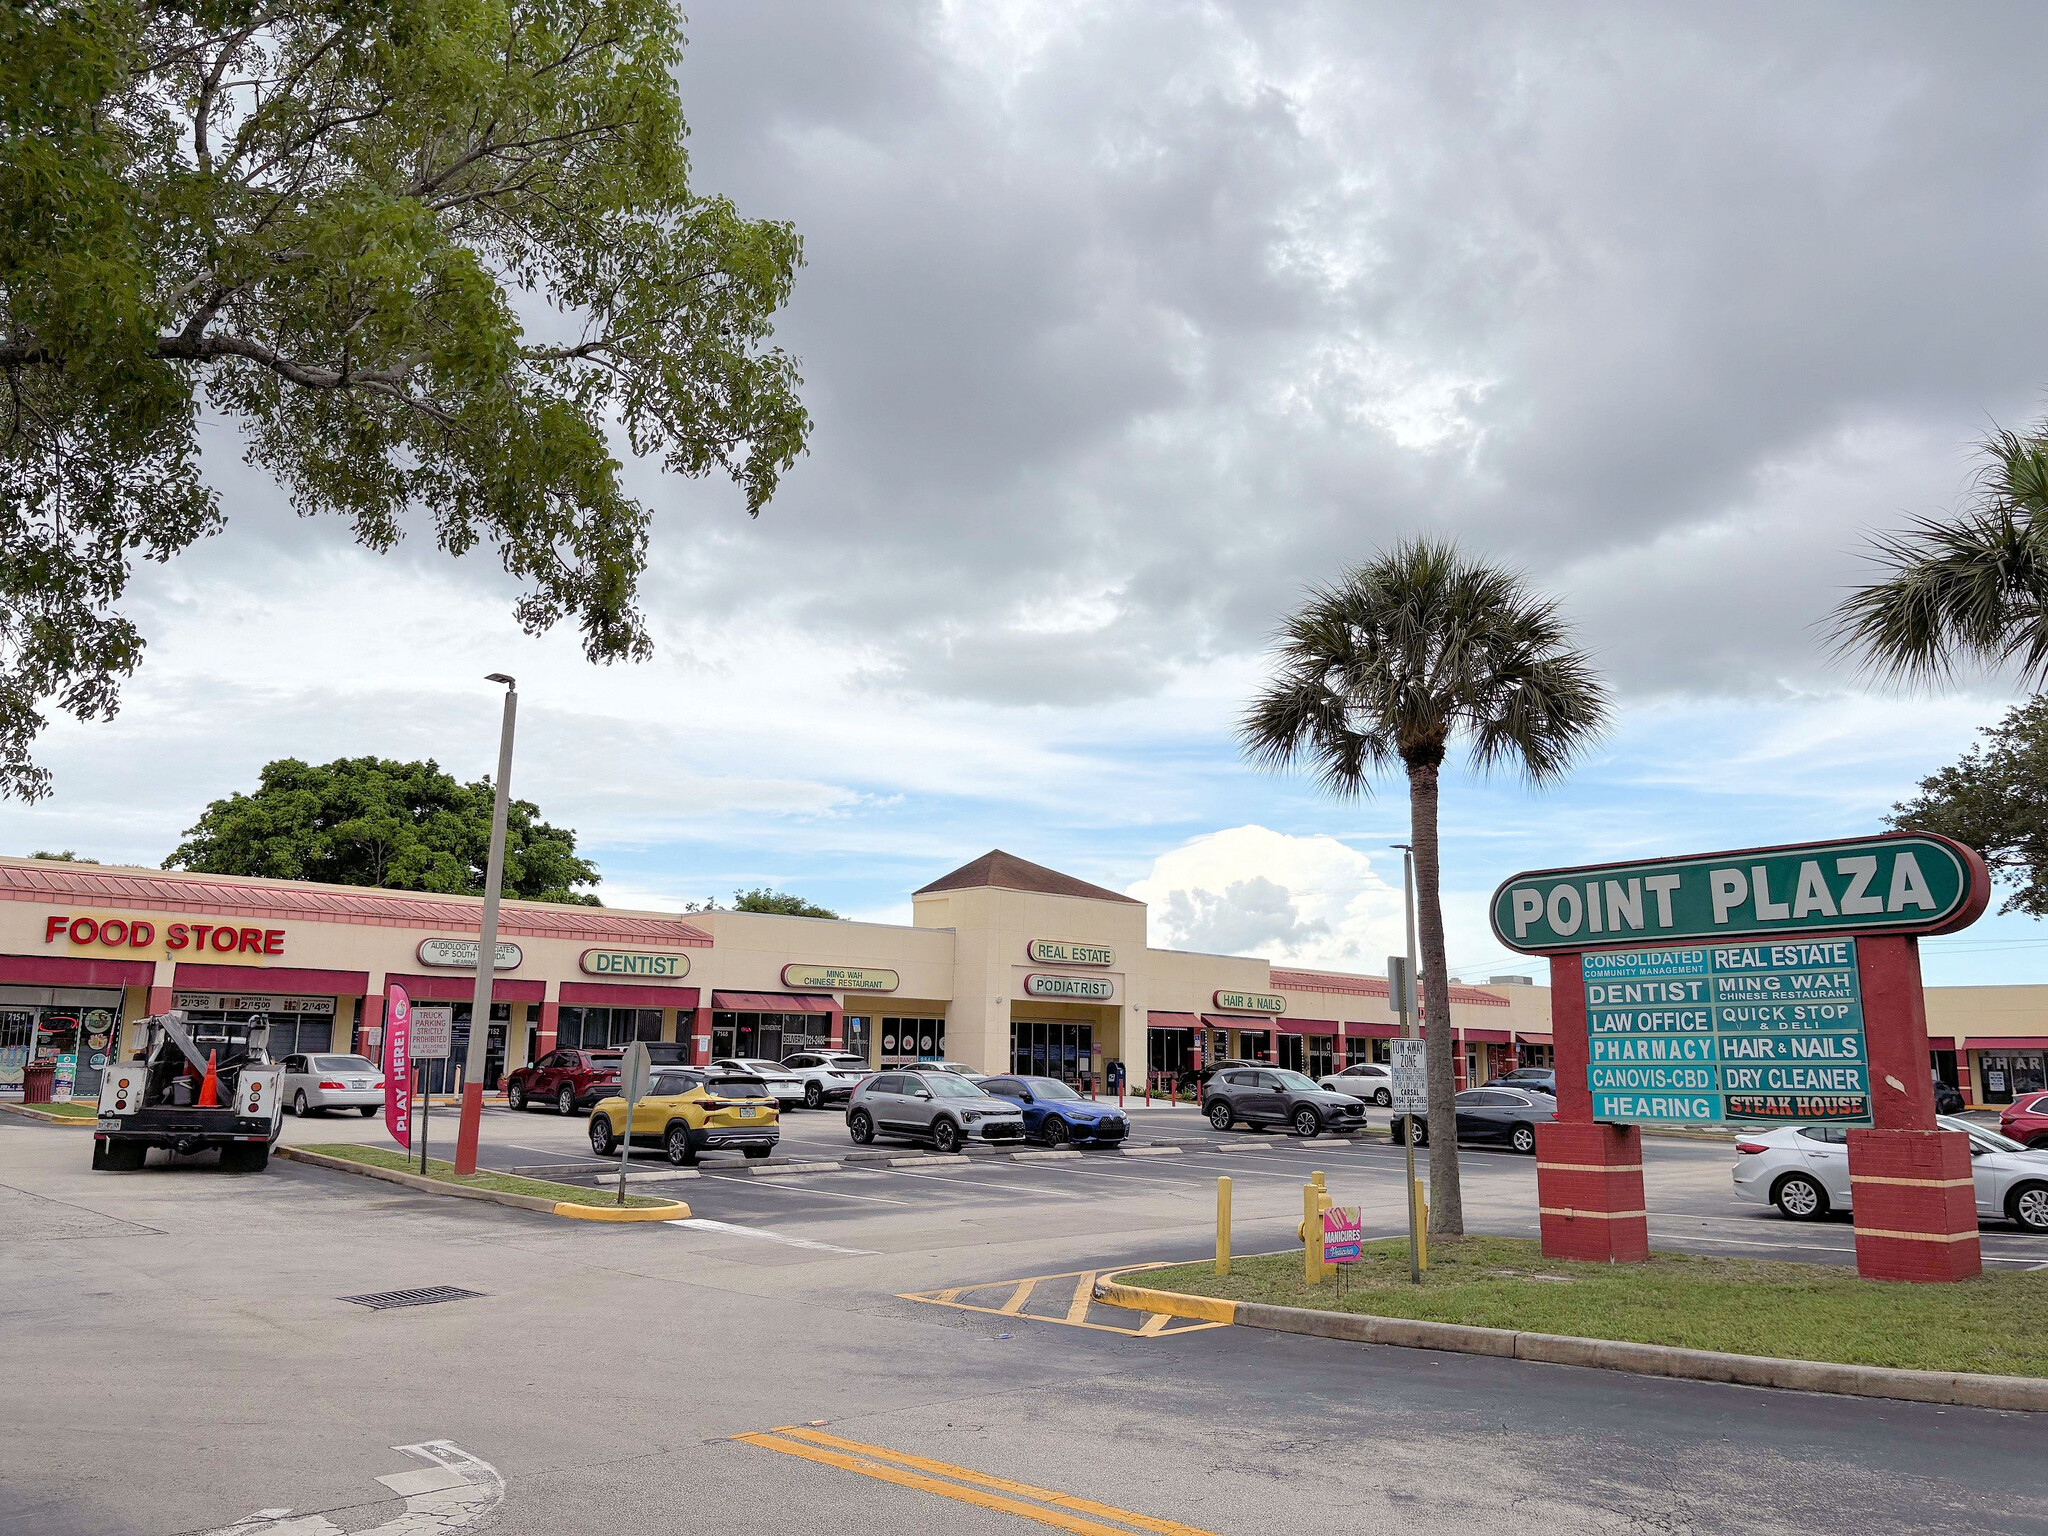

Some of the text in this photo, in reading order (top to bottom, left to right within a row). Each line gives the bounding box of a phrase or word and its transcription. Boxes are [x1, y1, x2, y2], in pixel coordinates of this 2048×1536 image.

[1512, 852, 1938, 939] POINT PLAZA
[45, 916, 286, 955] FOOD STORE
[431, 942, 470, 951] AUDIOLOGY
[1038, 944, 1111, 963] REAL ESTATE
[1714, 943, 1848, 969] REAL ESTATE
[597, 954, 679, 975] DENTIST
[1584, 950, 1703, 969] CONSOLIDATED
[826, 970, 863, 980] MING WAH
[1585, 965, 1704, 978] COMMUNITY MANAGEMENT
[804, 977, 883, 989] CHINESE RESTAURANT
[1036, 980, 1107, 996] PODIATRIST
[1718, 973, 1850, 992] MING WAH
[1223, 994, 1281, 1011] HAIR & NAILS
[1589, 982, 1703, 1005] DENTIST
[1719, 988, 1851, 1001] CHINESE RESTAURANT
[8, 1013, 25, 1021] 7154
[1592, 1011, 1708, 1032] LAW OFFICE
[1722, 1004, 1849, 1022] QUICK STOP
[1760, 1021, 1820, 1030] & DELI
[393, 1031, 406, 1081] HERE!
[1392, 1041, 1423, 1055] TOW AWAY
[1594, 1039, 1712, 1060] PHARMACY
[1723, 1037, 1858, 1058] HAIR & NAILS
[1401, 1055, 1416, 1068] ZONE
[1592, 1068, 1709, 1089] CANOVIS-CBD
[1726, 1069, 1861, 1090] DRY CLEANER
[397, 1088, 407, 1132] PLAY
[1604, 1097, 1711, 1118] HEARING
[1731, 1096, 1863, 1116] STEAK HOUSE
[1324, 1229, 1360, 1244] MANICURES
